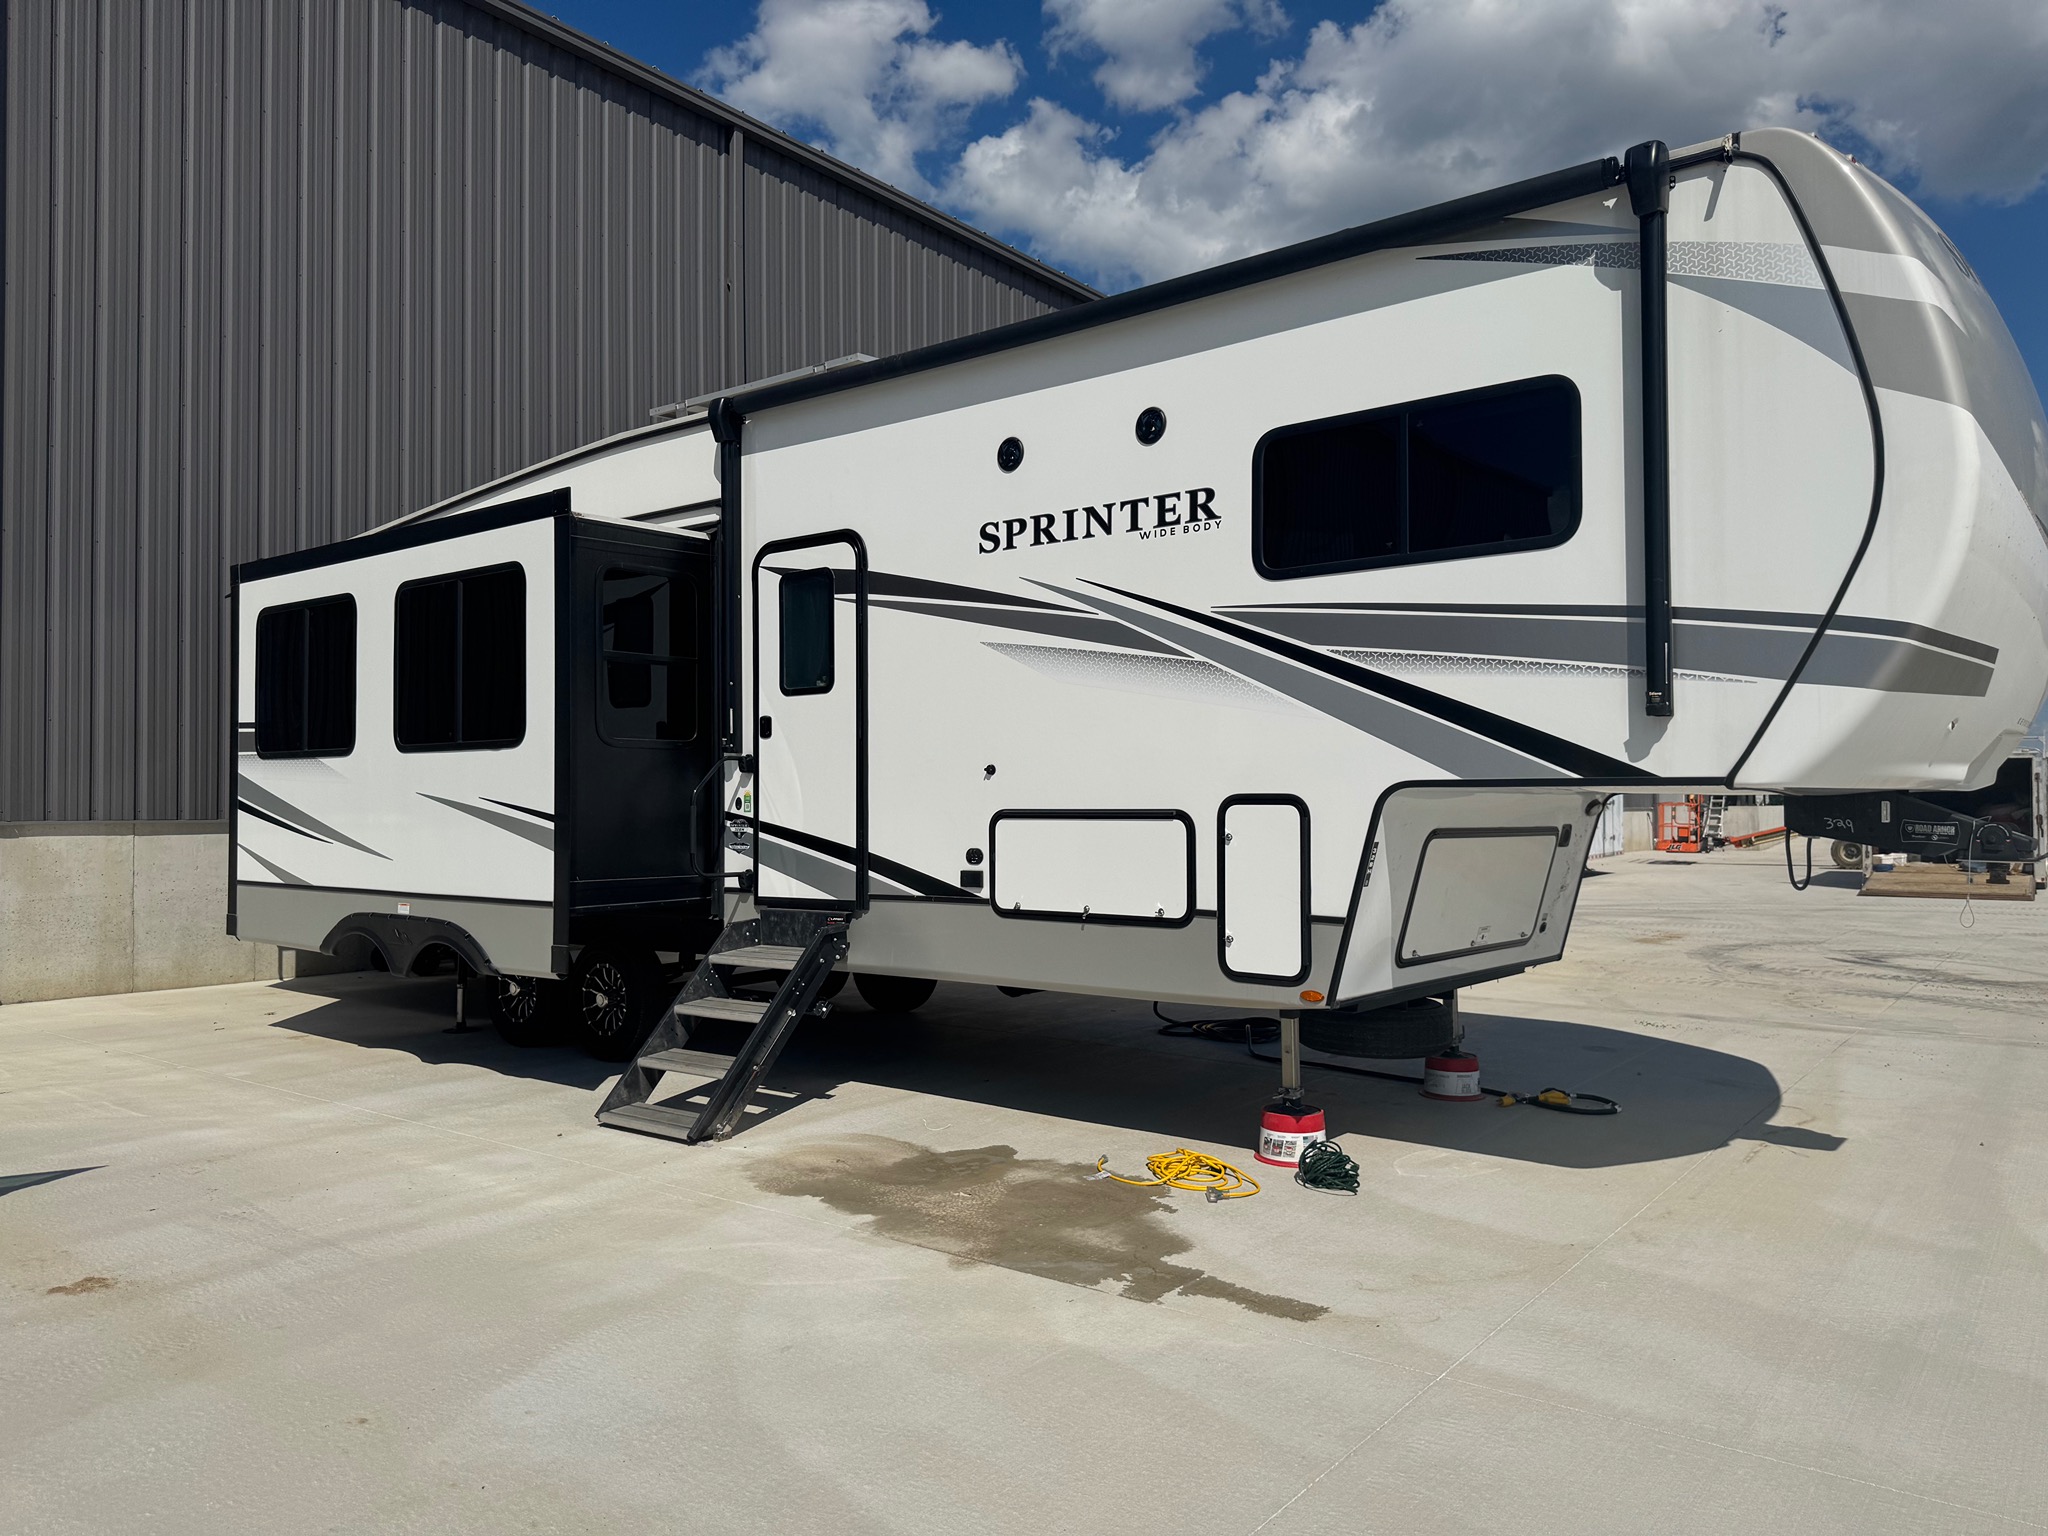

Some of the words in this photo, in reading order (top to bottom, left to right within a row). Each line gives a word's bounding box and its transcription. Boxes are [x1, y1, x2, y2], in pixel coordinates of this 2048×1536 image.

[978, 486, 1222, 554] SPRINTER
[1139, 527, 1176, 540] WIDE
[1183, 520, 1223, 534] BODY
[1823, 817, 1854, 833] 329
